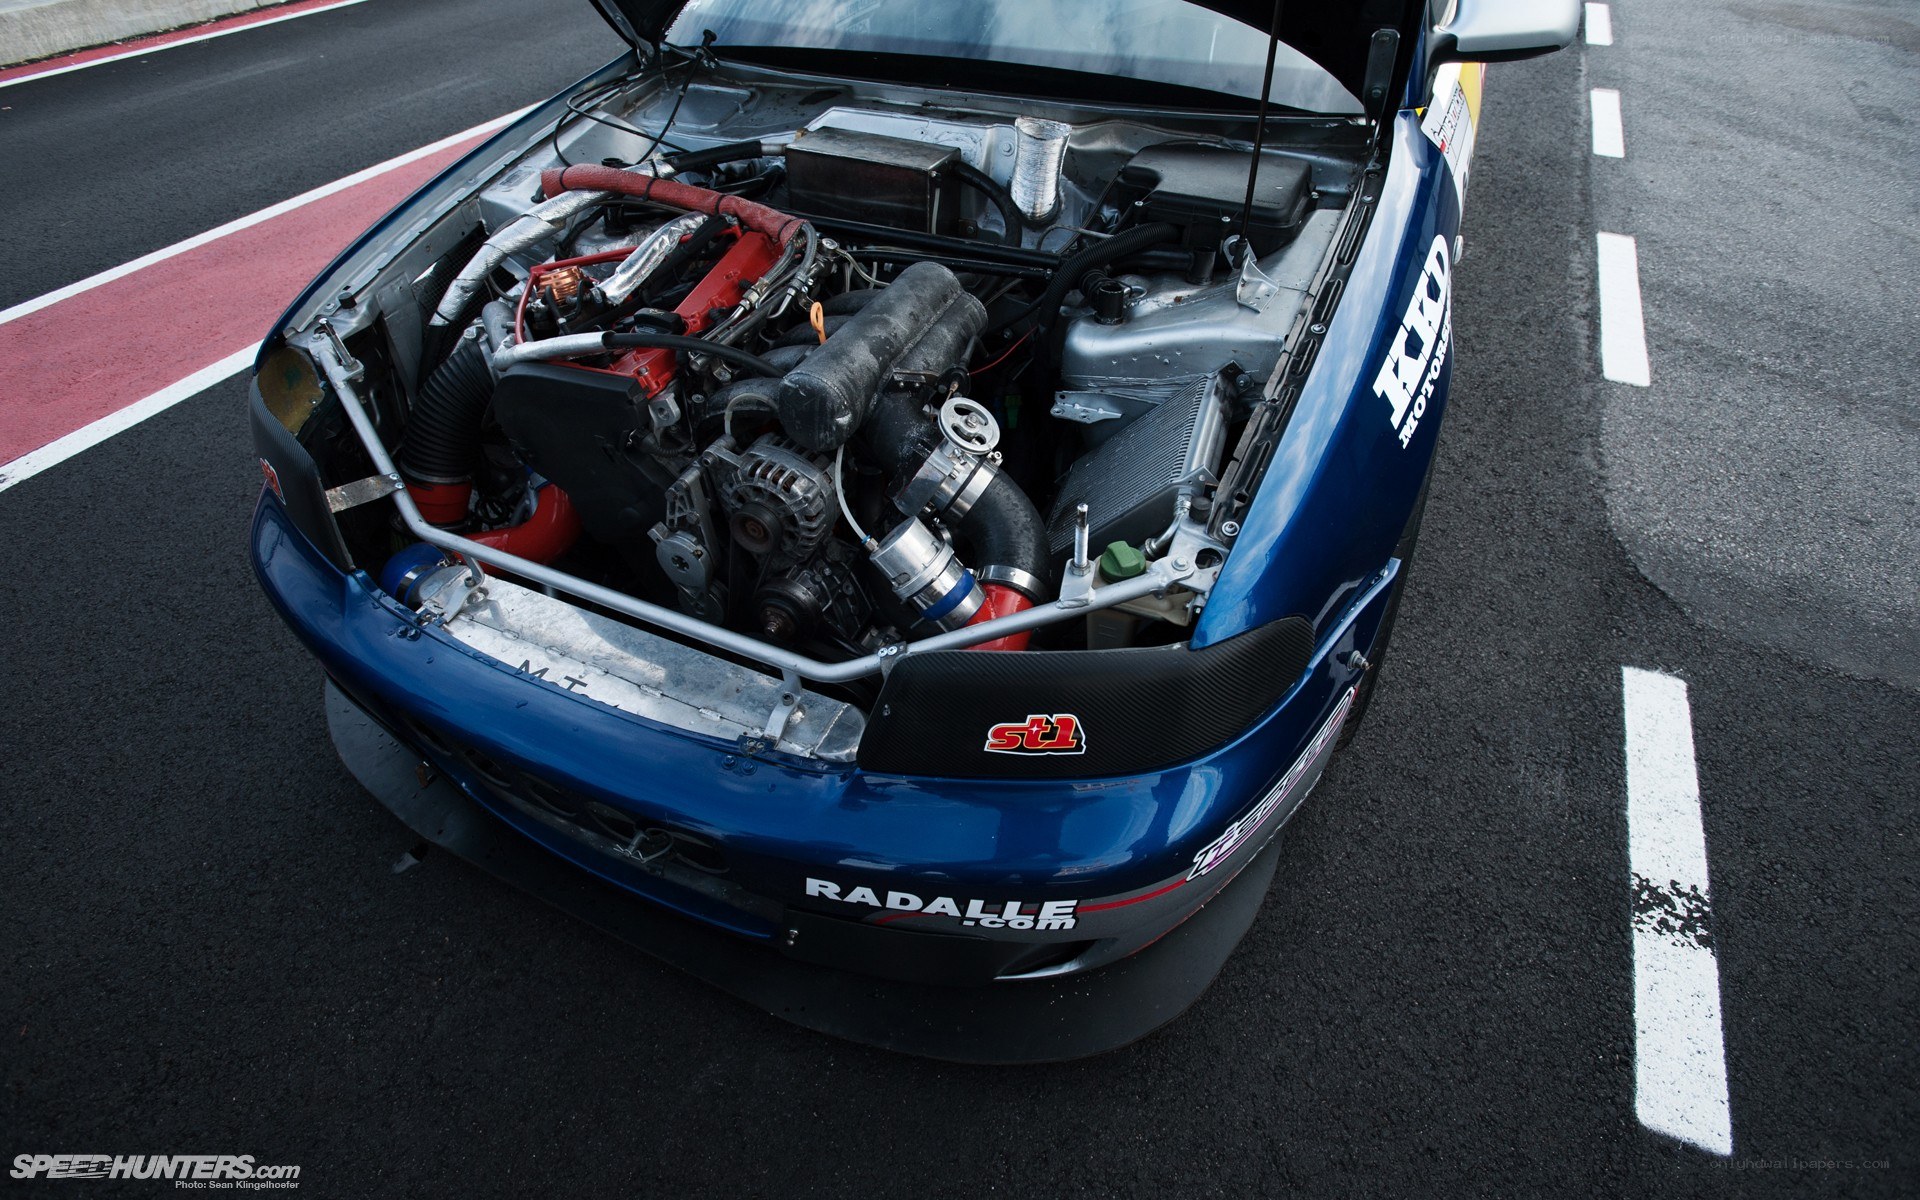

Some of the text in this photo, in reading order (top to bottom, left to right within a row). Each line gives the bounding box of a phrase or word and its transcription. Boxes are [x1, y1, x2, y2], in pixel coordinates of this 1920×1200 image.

[1372, 234, 1449, 430] KKD
[805, 877, 1078, 920] RADALLE
[962, 917, 1077, 931] .com
